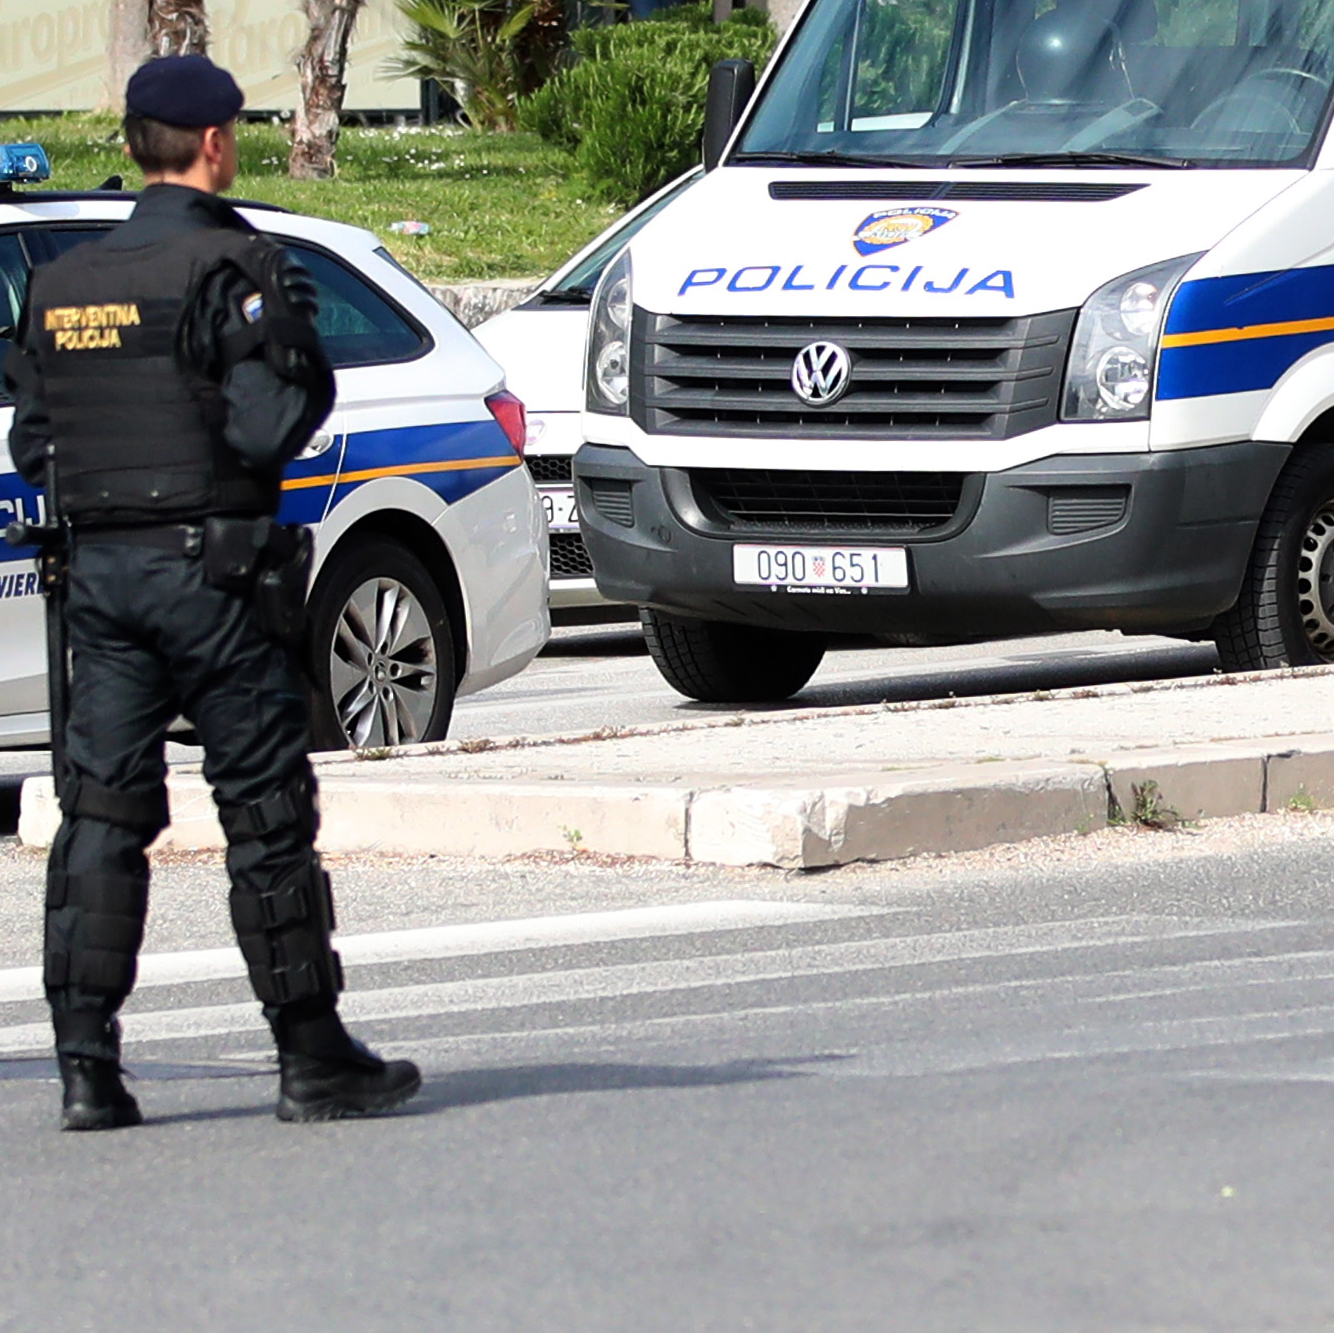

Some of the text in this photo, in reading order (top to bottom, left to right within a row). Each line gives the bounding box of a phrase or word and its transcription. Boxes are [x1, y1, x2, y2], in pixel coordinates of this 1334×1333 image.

[677, 264, 1016, 300] POLICIJA
[54, 328, 123, 352] POLICIJA
[757, 549, 880, 584] 090 651
